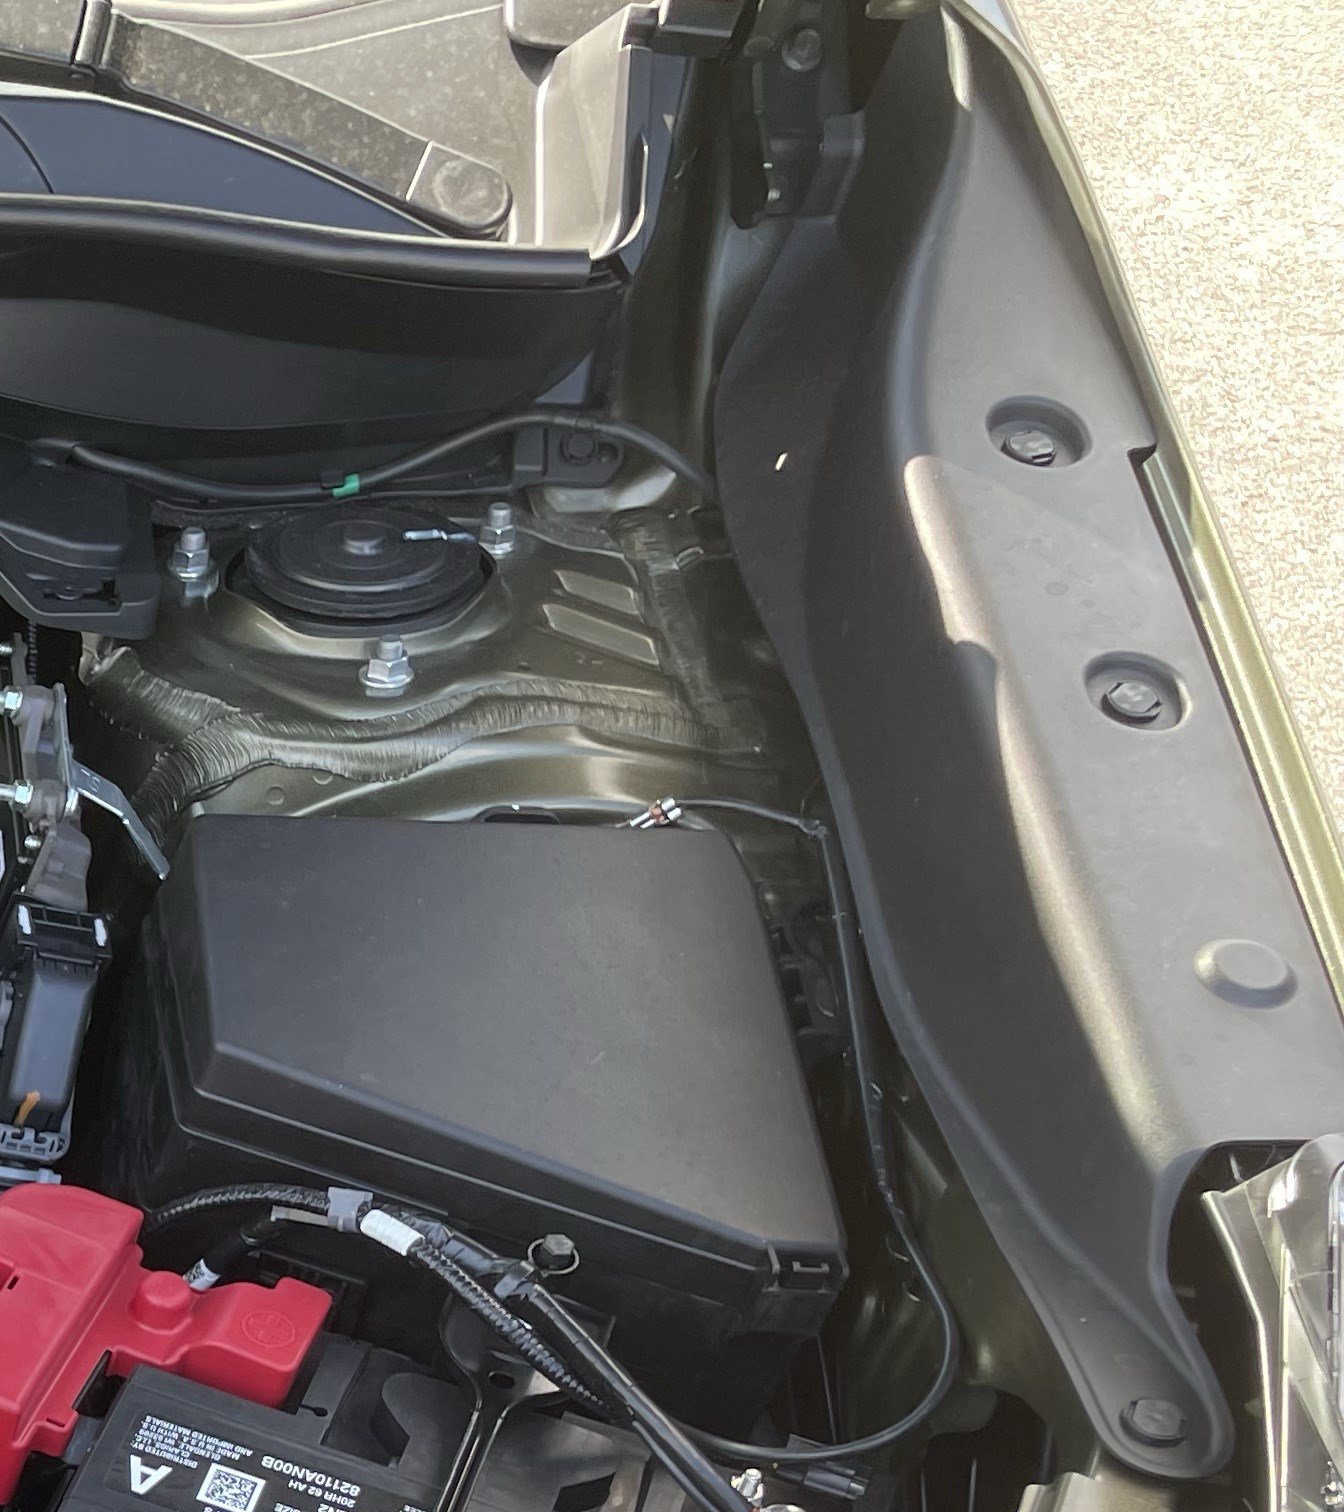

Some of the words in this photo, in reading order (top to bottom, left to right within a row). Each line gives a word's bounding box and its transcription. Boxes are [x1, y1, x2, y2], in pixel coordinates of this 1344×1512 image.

[190, 1429, 234, 1451] IMPORTED
[205, 1443, 215, 1451] IN
[214, 1446, 240, 1460] MADE
[233, 1444, 253, 1457] AND
[119, 1453, 172, 1500] A
[260, 1453, 361, 1498] 82110AN00B
[287, 1478, 307, 1492] AH
[307, 1485, 323, 1497] 62
[322, 1490, 356, 1509] 20HR
